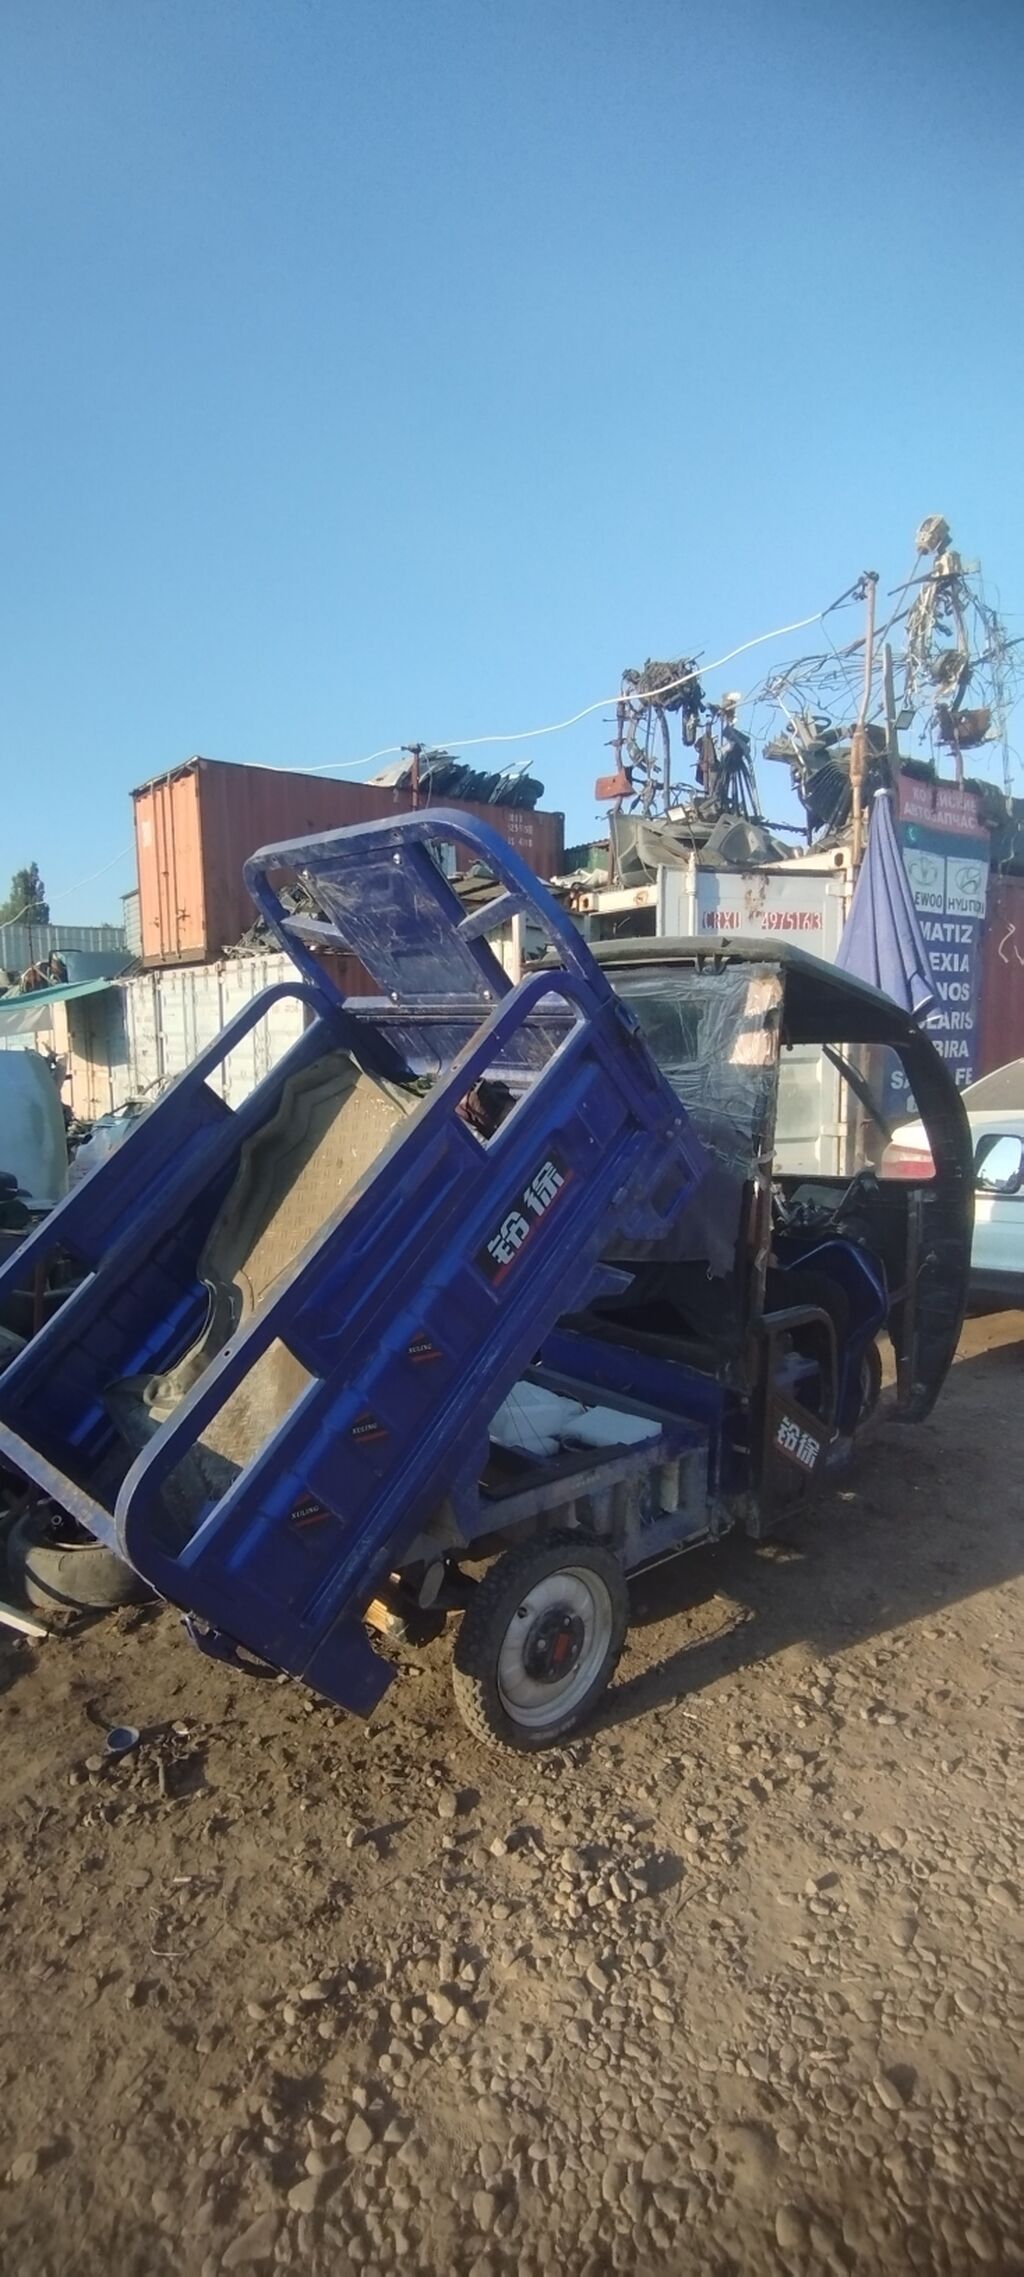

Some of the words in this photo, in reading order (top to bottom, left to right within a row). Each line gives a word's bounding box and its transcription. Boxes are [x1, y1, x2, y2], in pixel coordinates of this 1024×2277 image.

[914, 891, 943, 909] EWOO
[929, 951, 969, 973] EXIA
[936, 981, 970, 1001] NOS
